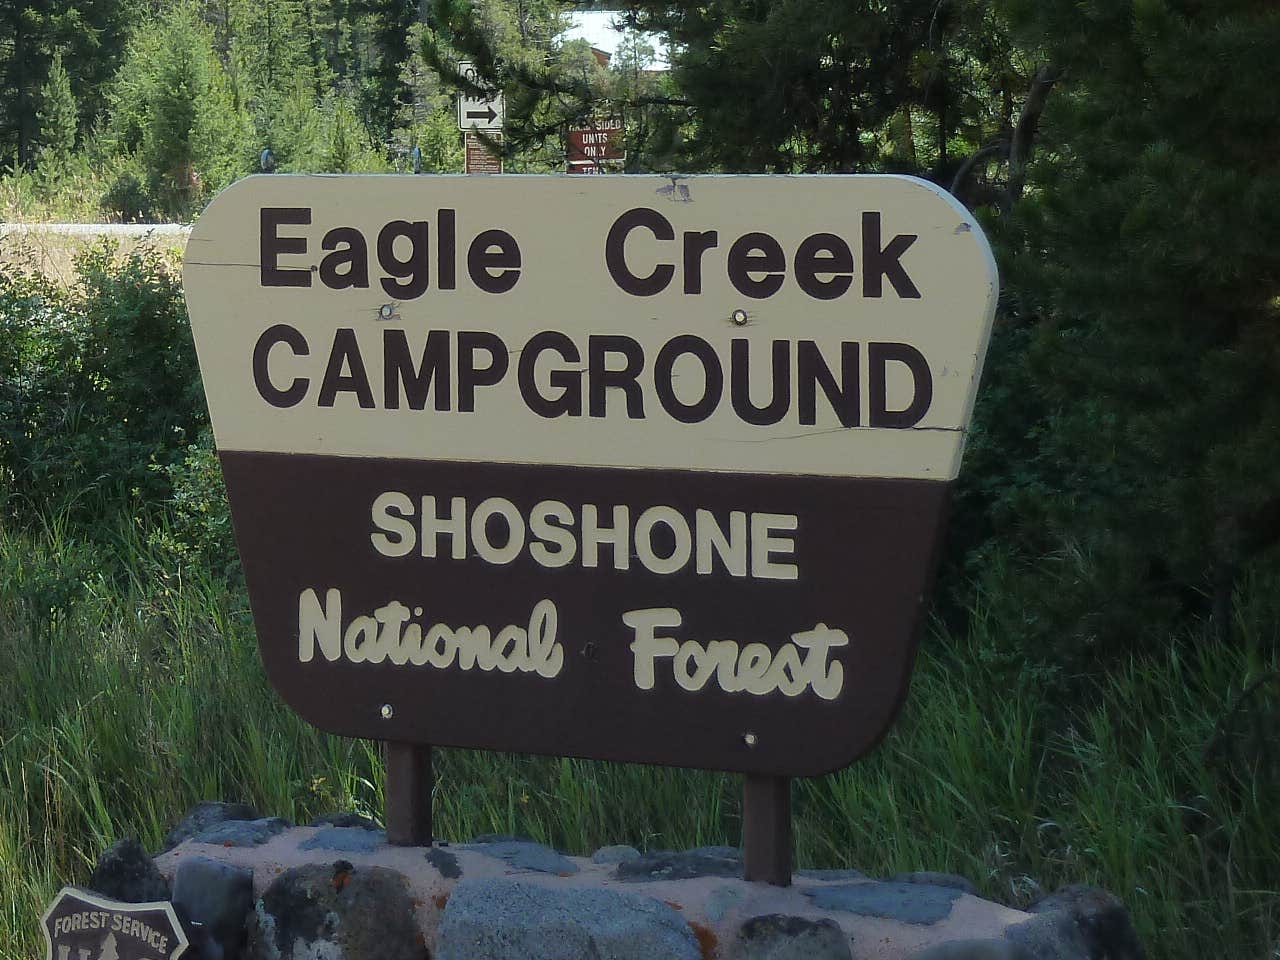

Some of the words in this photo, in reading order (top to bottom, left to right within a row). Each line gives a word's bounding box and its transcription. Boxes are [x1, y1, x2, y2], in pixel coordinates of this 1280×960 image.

[582, 133, 608, 144] UNITS
[584, 146, 606, 157] ONY
[259, 207, 522, 301] Eagle
[605, 207, 922, 300] Creek
[252, 323, 934, 430] CAMPGROUND
[370, 491, 800, 581] SHOSHONE
[298, 588, 564, 678] National
[622, 607, 849, 700] Forest
[54, 912, 110, 938] FOREST
[111, 914, 169, 954] SERVICE
